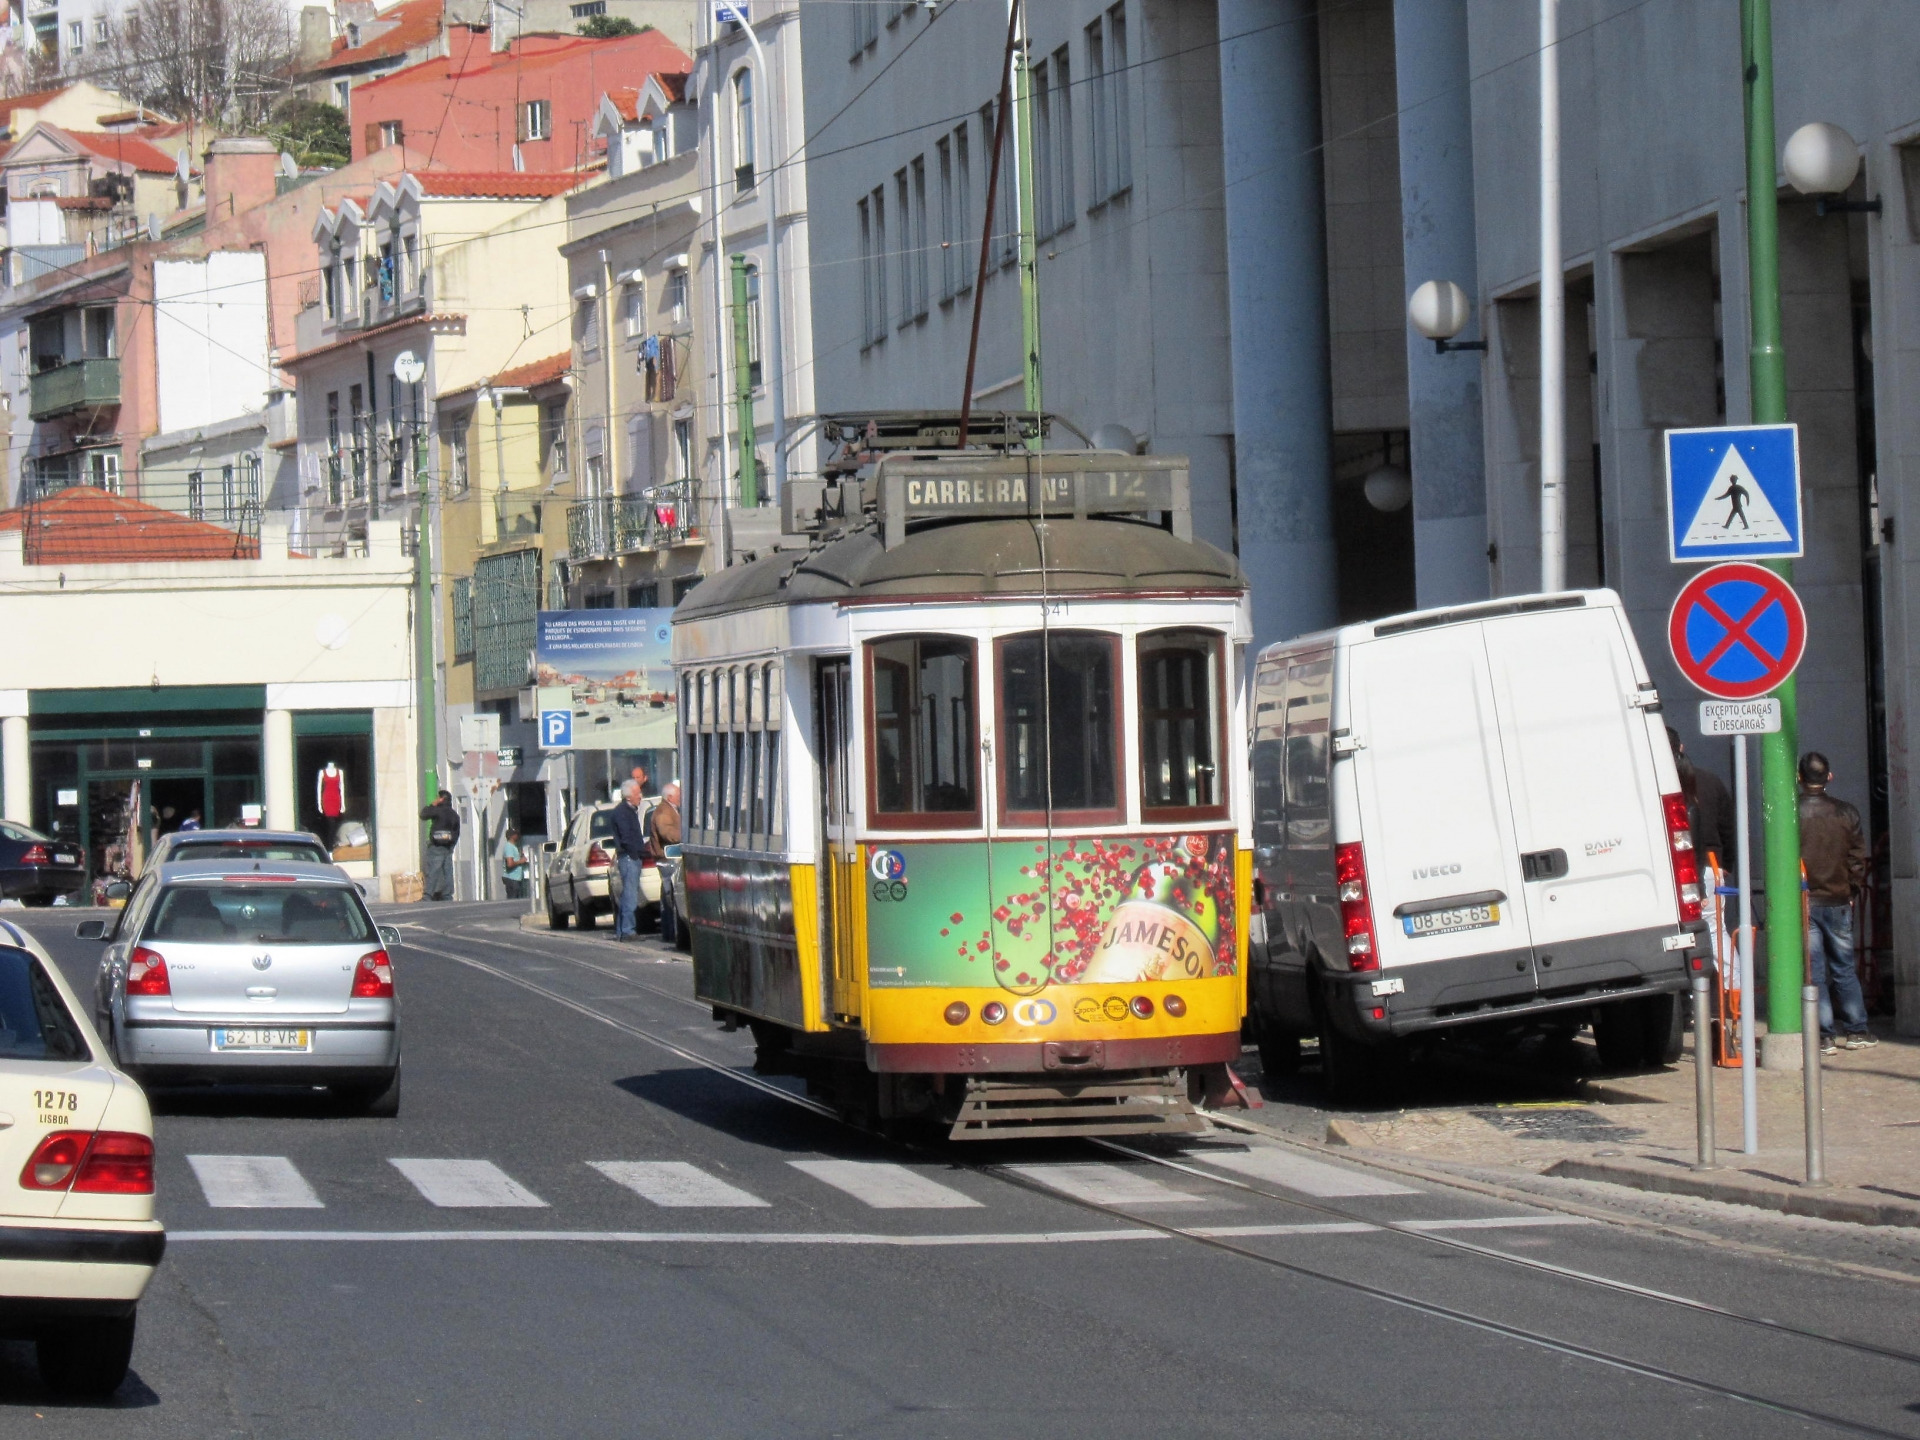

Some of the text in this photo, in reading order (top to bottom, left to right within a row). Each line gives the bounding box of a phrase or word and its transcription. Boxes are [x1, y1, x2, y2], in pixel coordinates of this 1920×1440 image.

[908, 479, 1027, 505] CARREIRA
[1104, 472, 1146, 498] 12
[1040, 601, 1069, 617] 541
[1705, 703, 1772, 717] EXCEPTO CARGAS
[549, 720, 565, 743] P
[1713, 718, 1766, 731] E DESCARGAS
[1584, 838, 1622, 851] DAILY
[1412, 863, 1462, 880] IVECO
[33, 1090, 78, 1111] 1278
[39, 1113, 69, 1125] LISBOA
